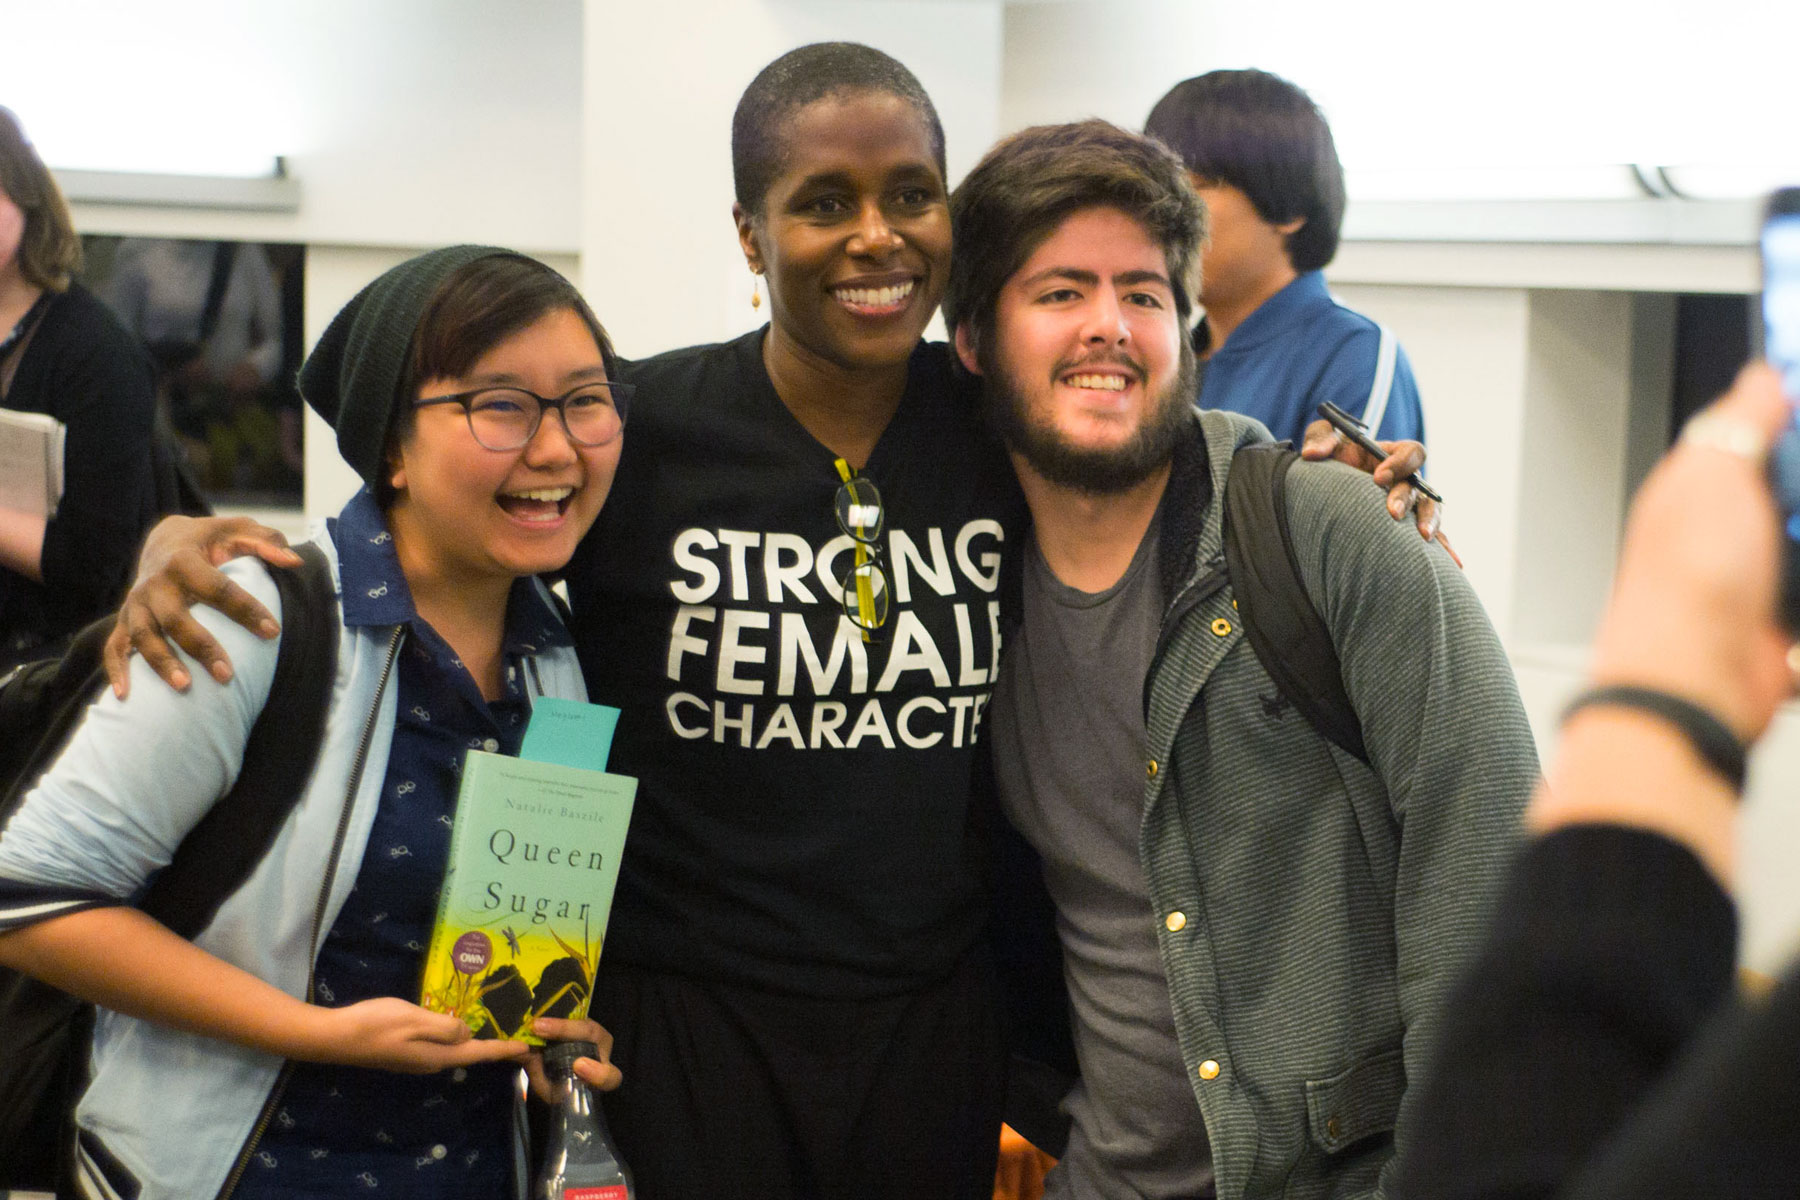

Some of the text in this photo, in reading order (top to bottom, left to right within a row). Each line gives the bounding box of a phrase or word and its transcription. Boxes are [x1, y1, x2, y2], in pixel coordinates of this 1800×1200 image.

[669, 518, 1005, 604] STRONG
[665, 691, 992, 750] CHARACTE
[504, 797, 553, 816] Natalie
[489, 828, 604, 871] Queen
[483, 881, 591, 925] Sugar
[460, 952, 485, 965] OWN
